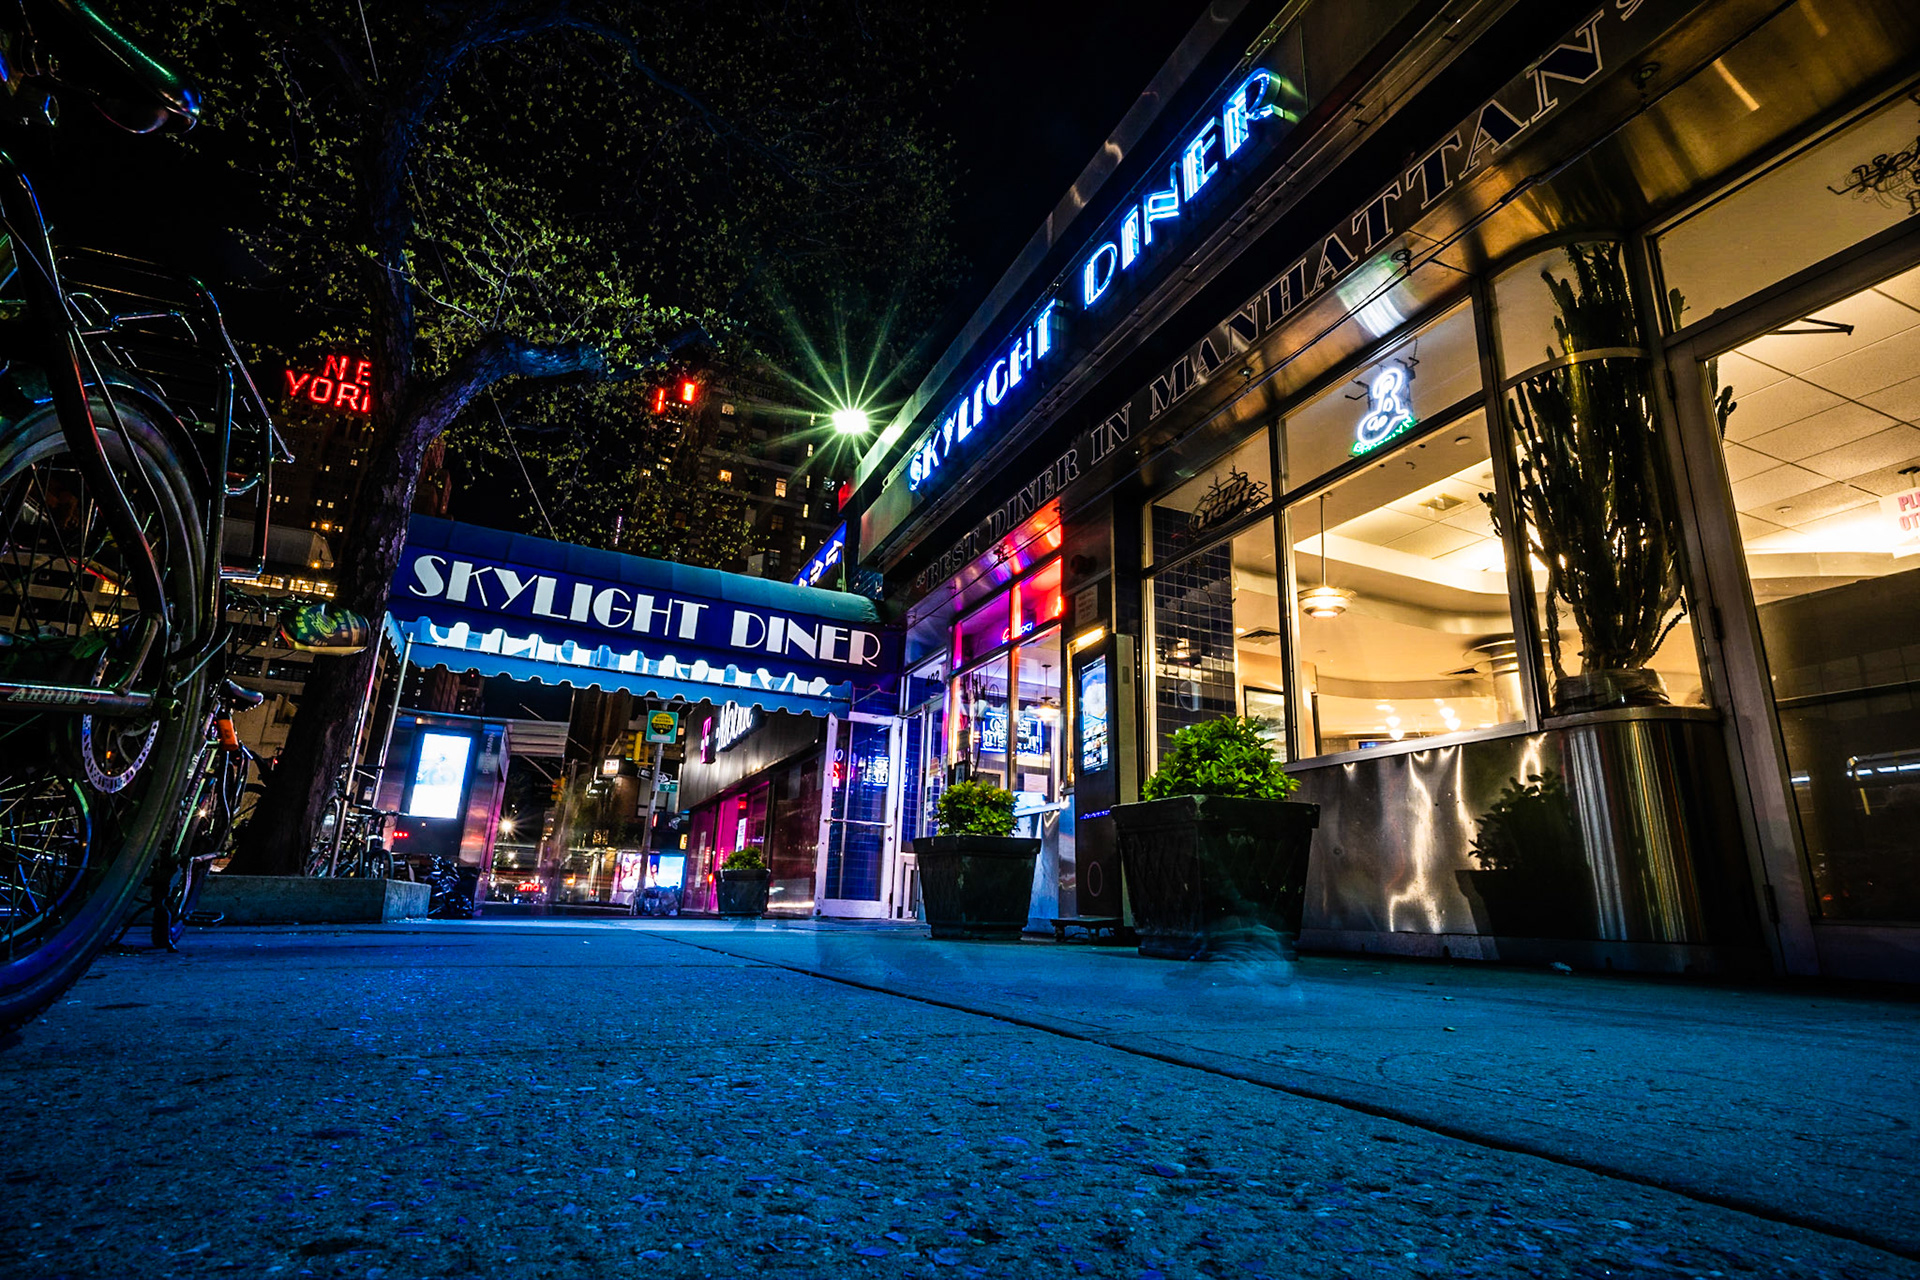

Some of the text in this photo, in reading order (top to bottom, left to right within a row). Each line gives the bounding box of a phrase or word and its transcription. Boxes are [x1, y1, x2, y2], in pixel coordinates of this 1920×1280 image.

[908, 67, 1275, 492] SKYLIGHT DINER
[988, 448, 1081, 545] DINER
[1090, 401, 1133, 466] IN
[408, 554, 709, 640] SKYLIGHT
[730, 609, 881, 668] DINER
